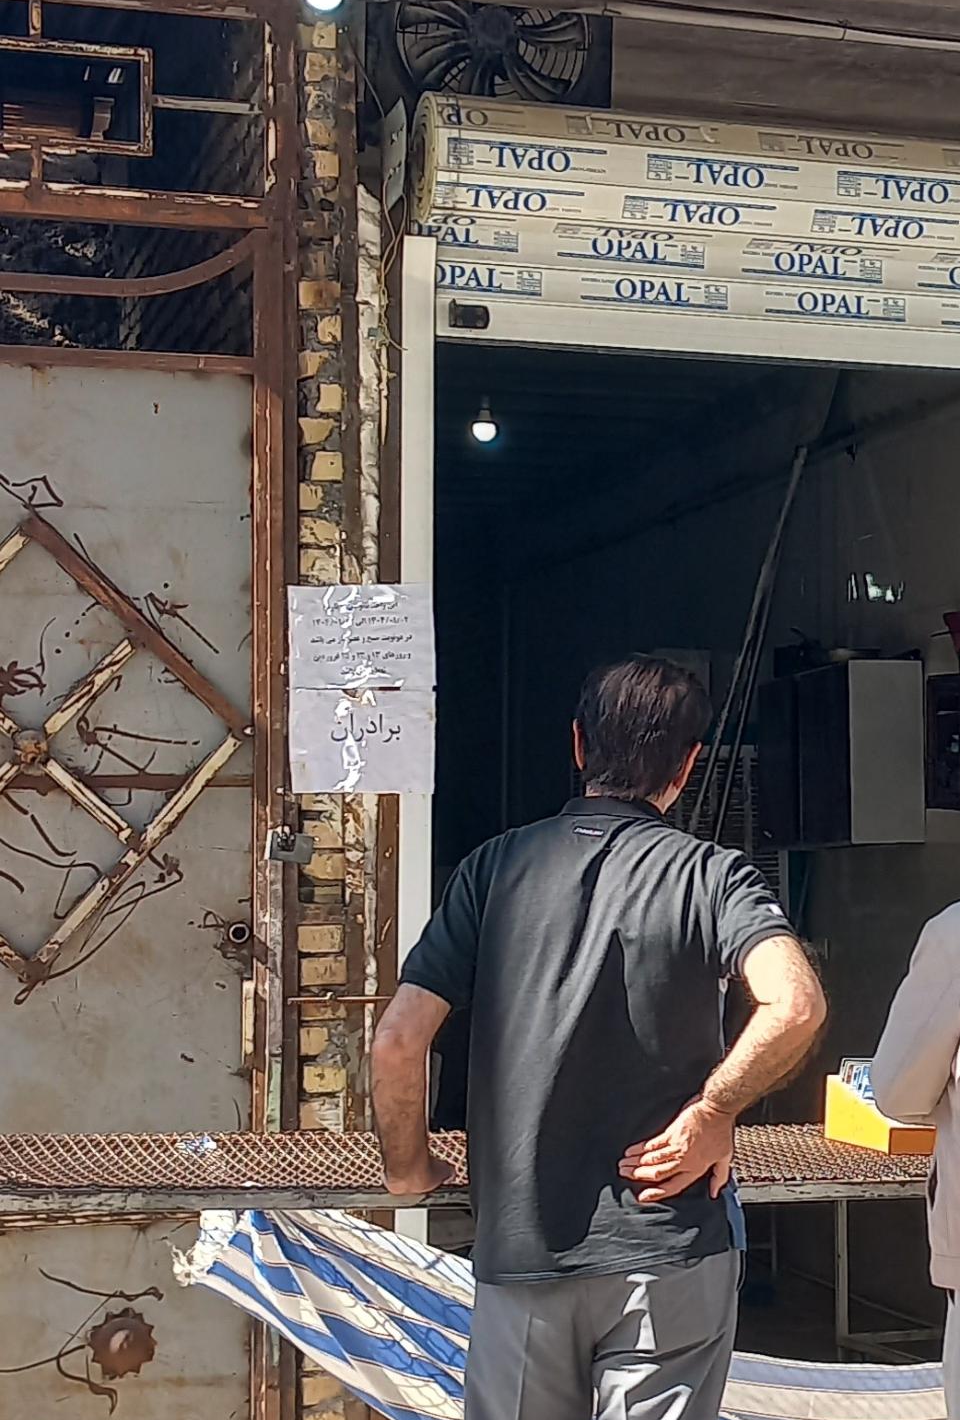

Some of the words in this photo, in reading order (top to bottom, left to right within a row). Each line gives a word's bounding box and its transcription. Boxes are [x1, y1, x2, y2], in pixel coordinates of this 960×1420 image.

[606, 121, 686, 143] OPAL
[489, 145, 571, 172] OPAL
[798, 137, 873, 160] OPAL
[686, 161, 765, 189] OPAL
[466, 188, 547, 212] OPAL
[874, 178, 949, 204] OPAL
[663, 203, 740, 226] OPAL
[851, 216, 924, 240] OPAL
[592, 238, 667, 260] OPAL
[775, 252, 846, 276] OPAL
[615, 278, 690, 302] OPAL
[797, 291, 869, 315] OPAL
[331, 713, 401, 743] برادران
